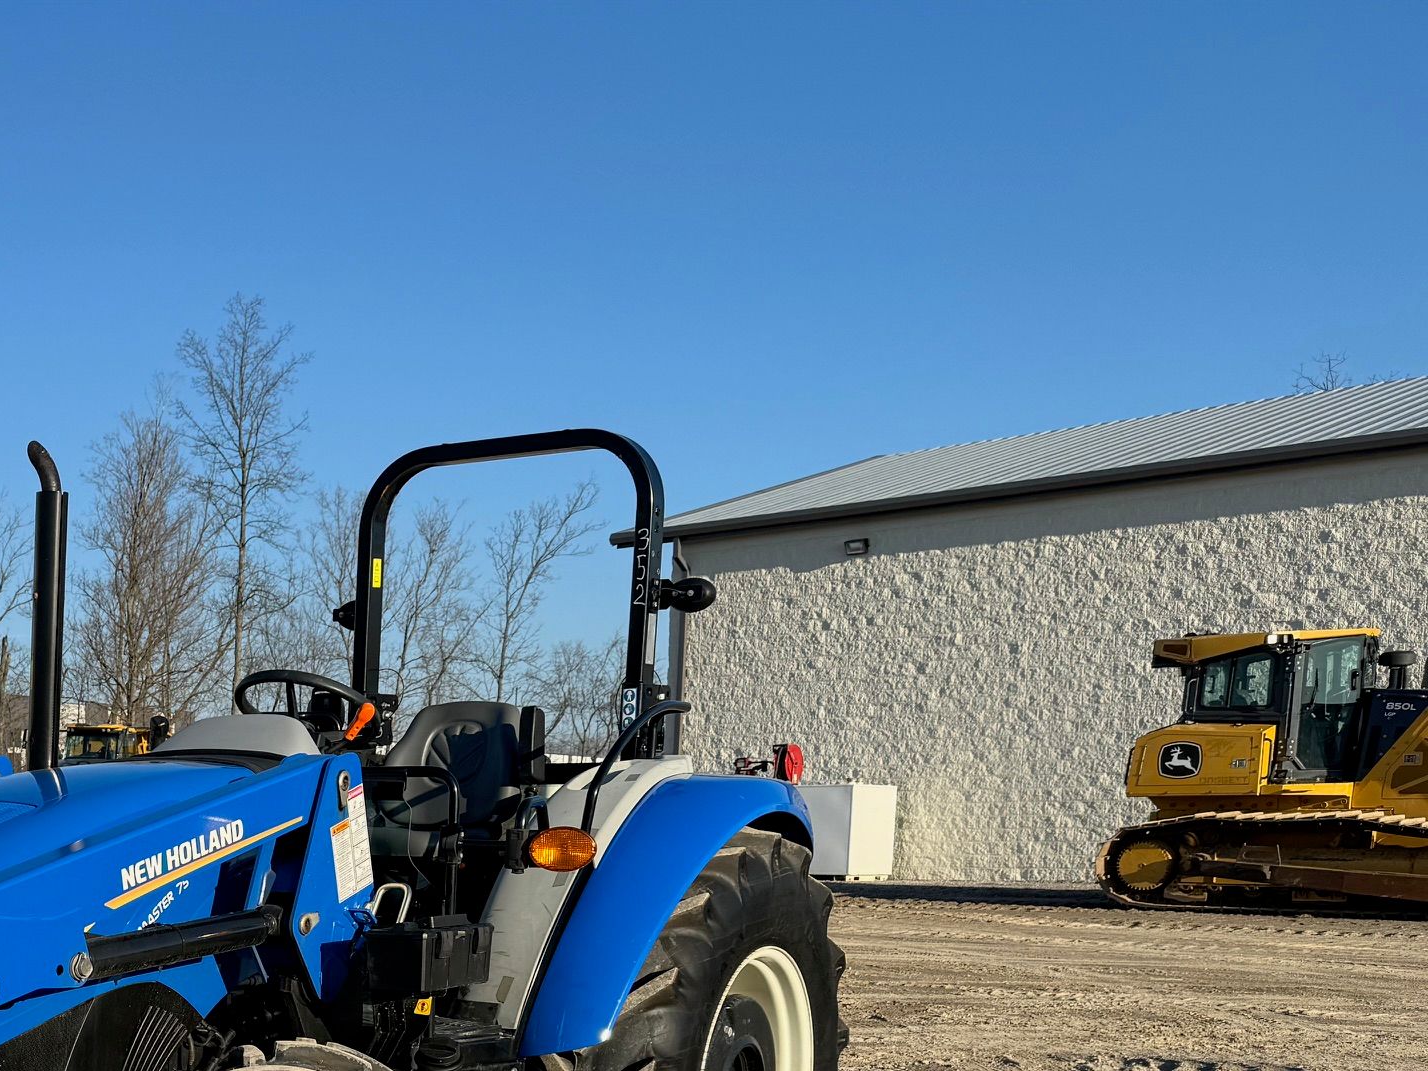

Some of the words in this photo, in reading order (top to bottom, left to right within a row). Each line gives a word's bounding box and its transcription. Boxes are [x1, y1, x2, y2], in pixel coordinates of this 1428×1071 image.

[633, 527, 650, 606] 352
[1385, 702, 1417, 711] 850L
[121, 853, 162, 890] NEW
[166, 819, 244, 871] HOLLAND
